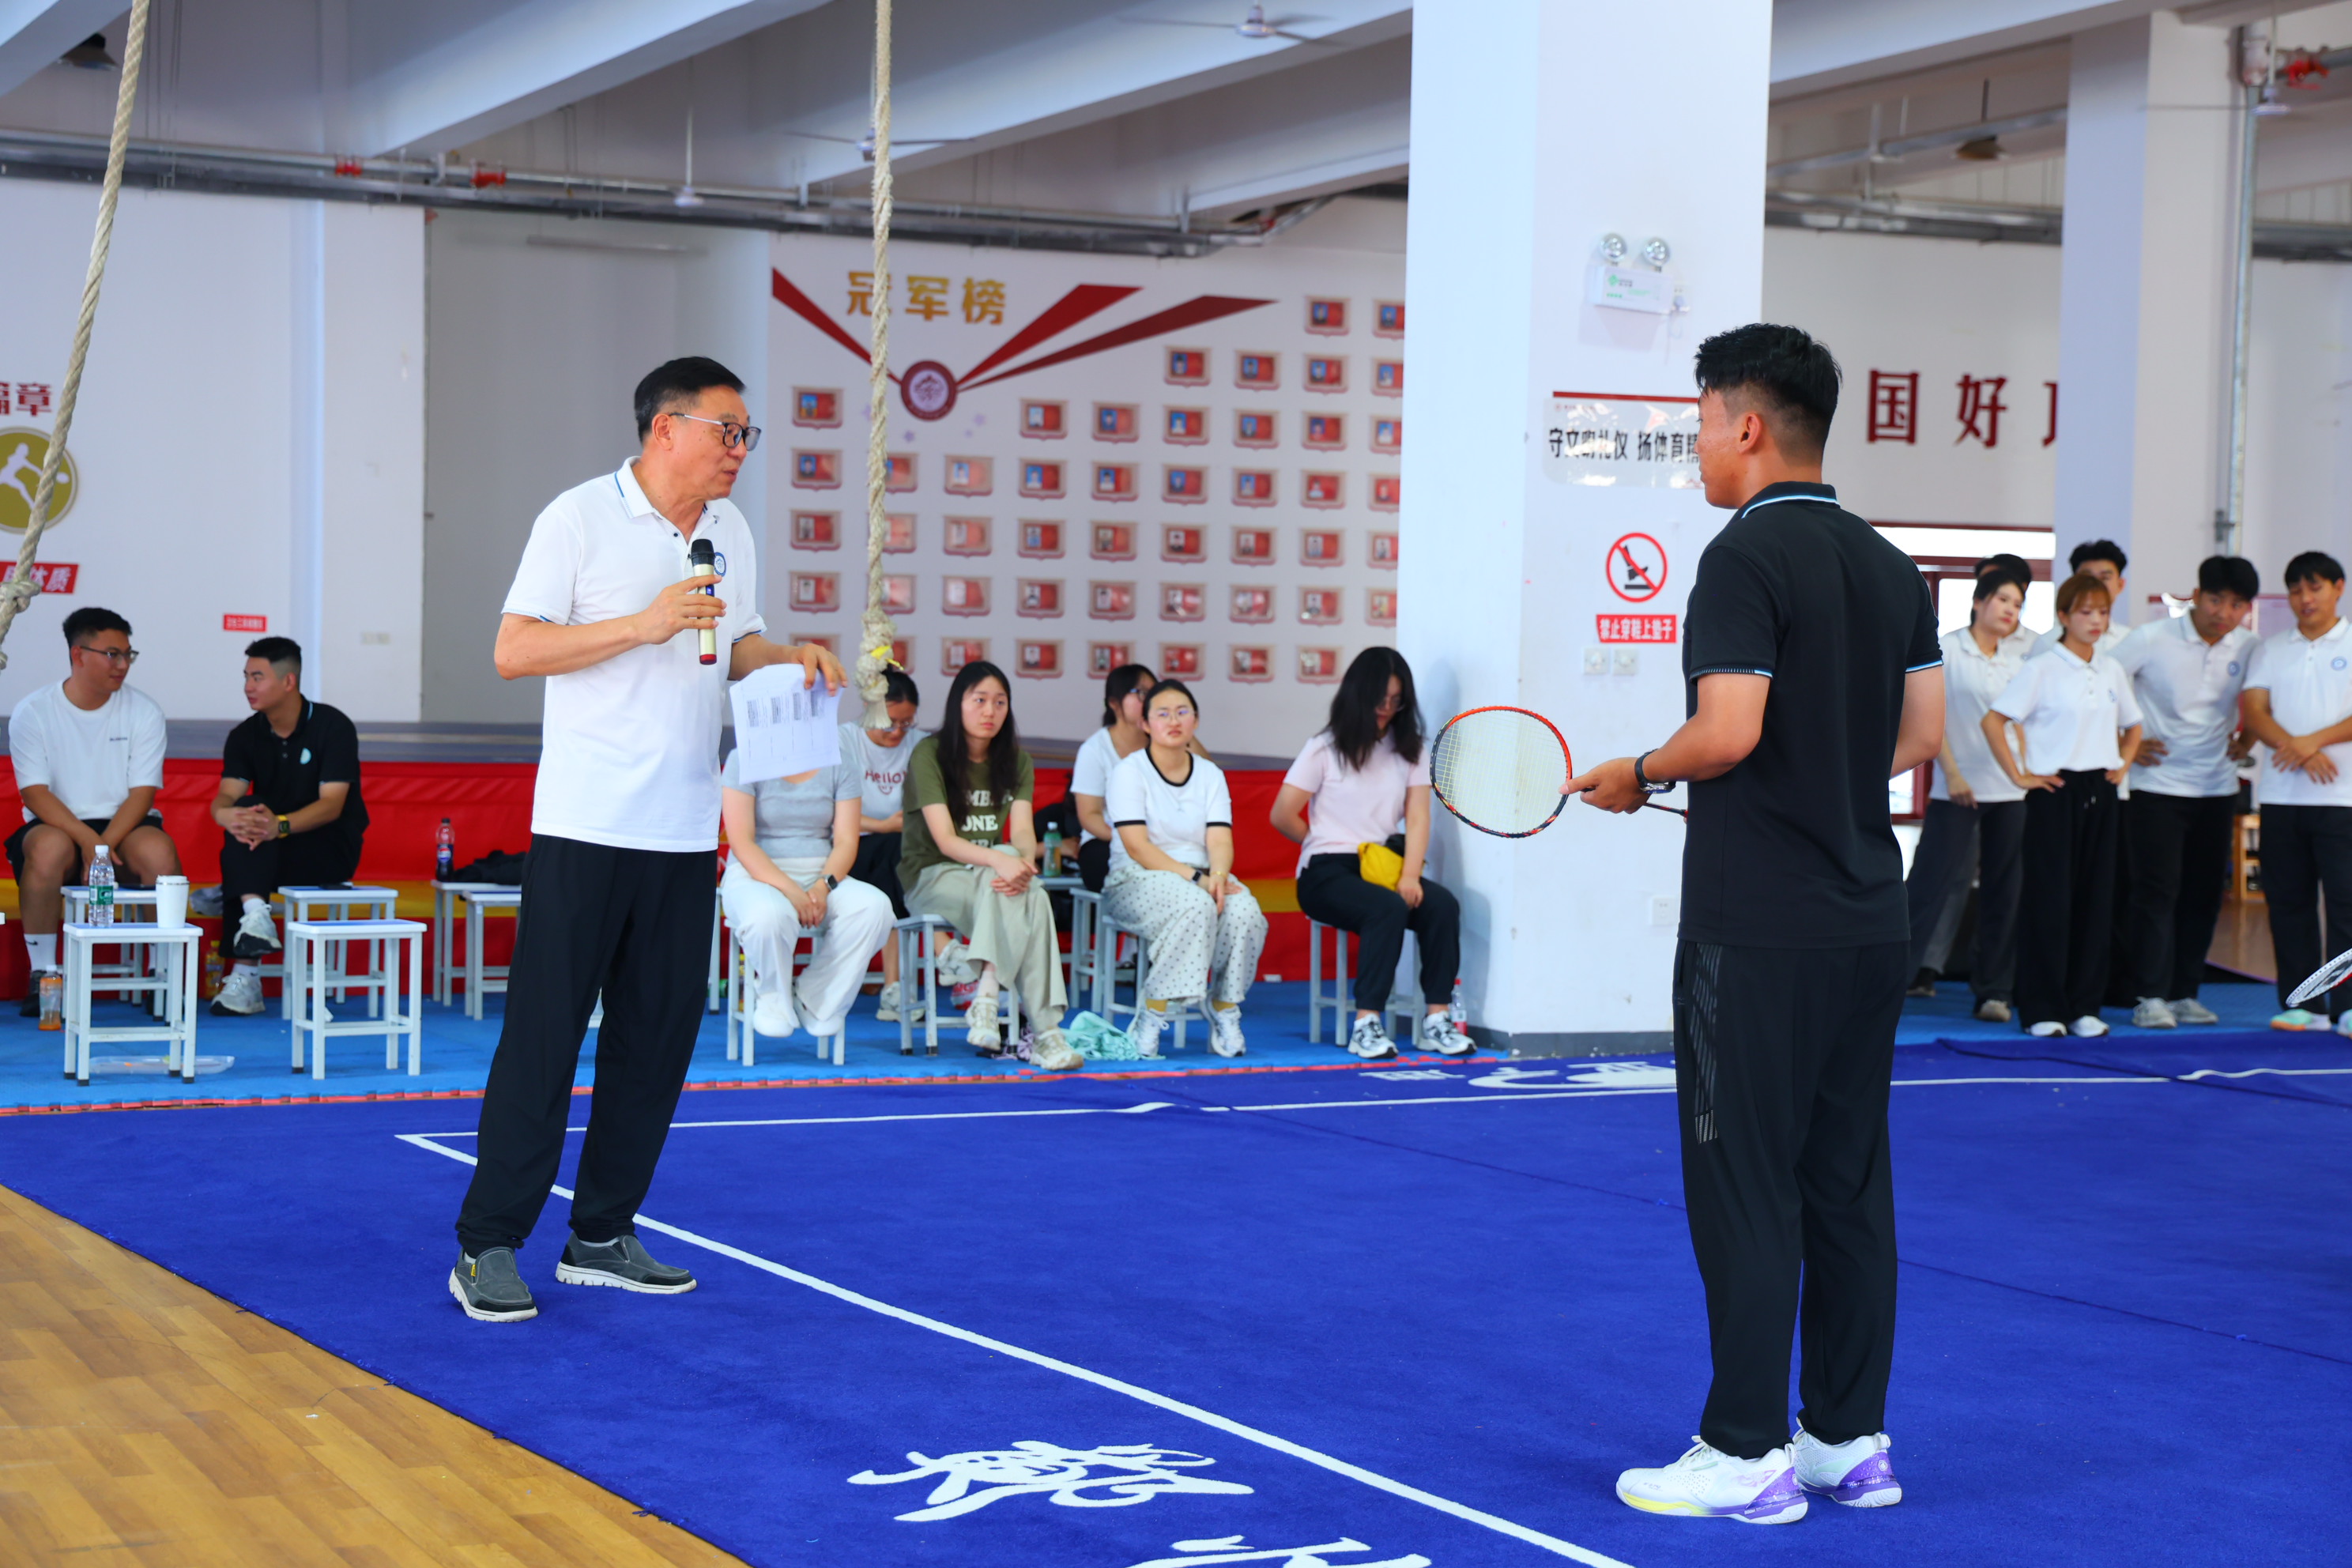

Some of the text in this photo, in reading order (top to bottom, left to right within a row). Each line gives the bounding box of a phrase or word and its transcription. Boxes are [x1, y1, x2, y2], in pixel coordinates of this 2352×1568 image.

[846, 270, 1006, 326] 冠军榜
[1866, 369, 2057, 449] 国好
